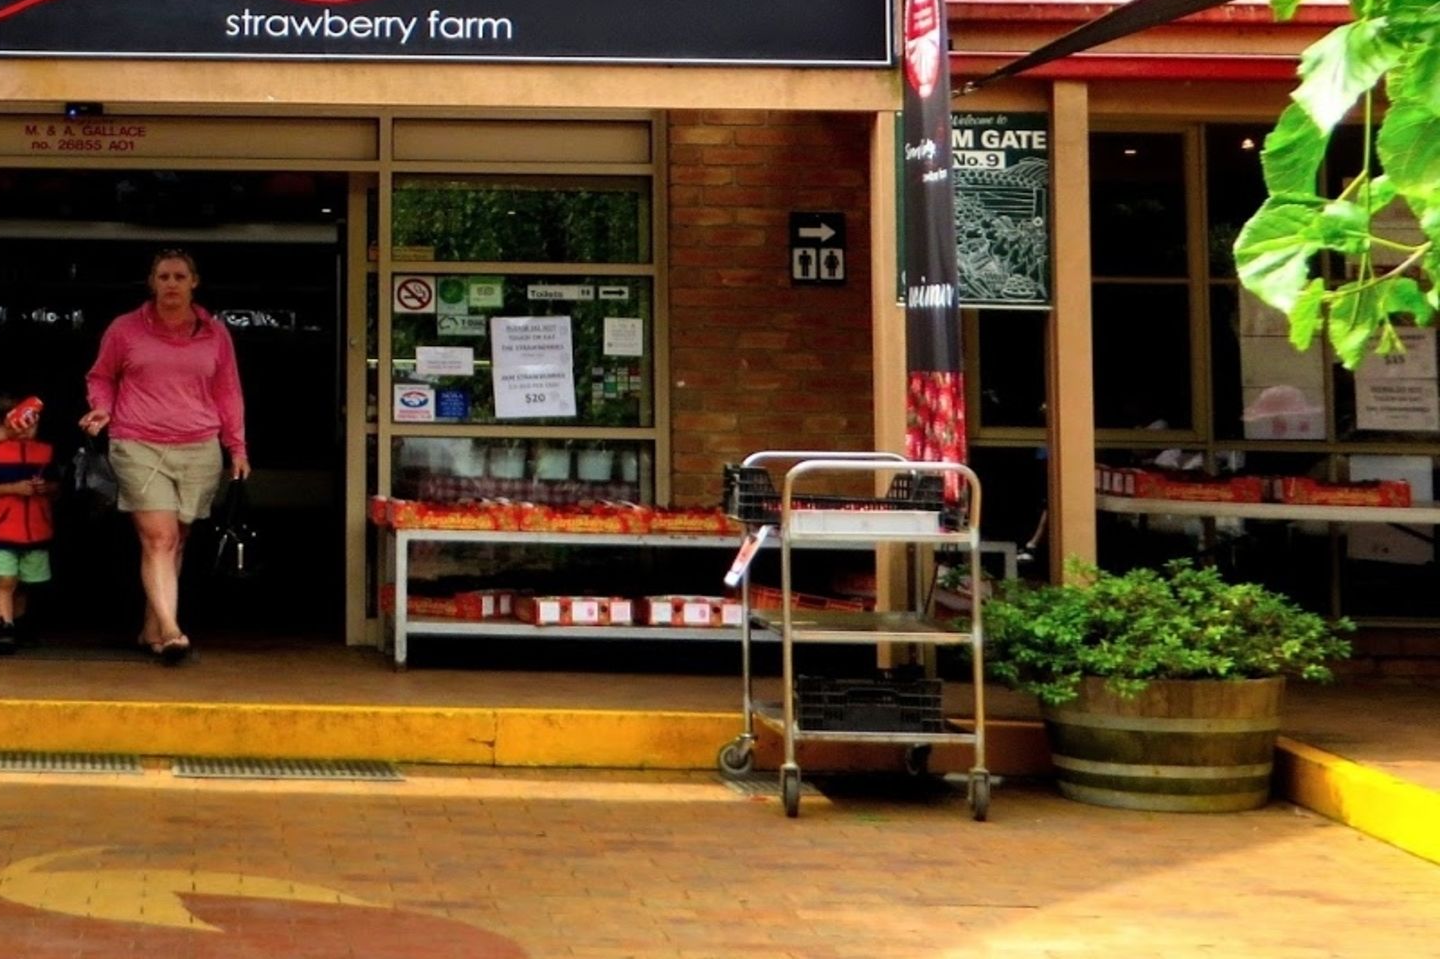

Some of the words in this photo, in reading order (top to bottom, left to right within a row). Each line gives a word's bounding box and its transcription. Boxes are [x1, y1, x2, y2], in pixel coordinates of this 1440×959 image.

[225, 8, 417, 44] strawberry
[427, 9, 513, 40] farm
[81, 125, 146, 138] GALLACE
[981, 129, 1047, 149] GATE
[985, 153, 1000, 167] 9
[525, 393, 546, 404] $20
